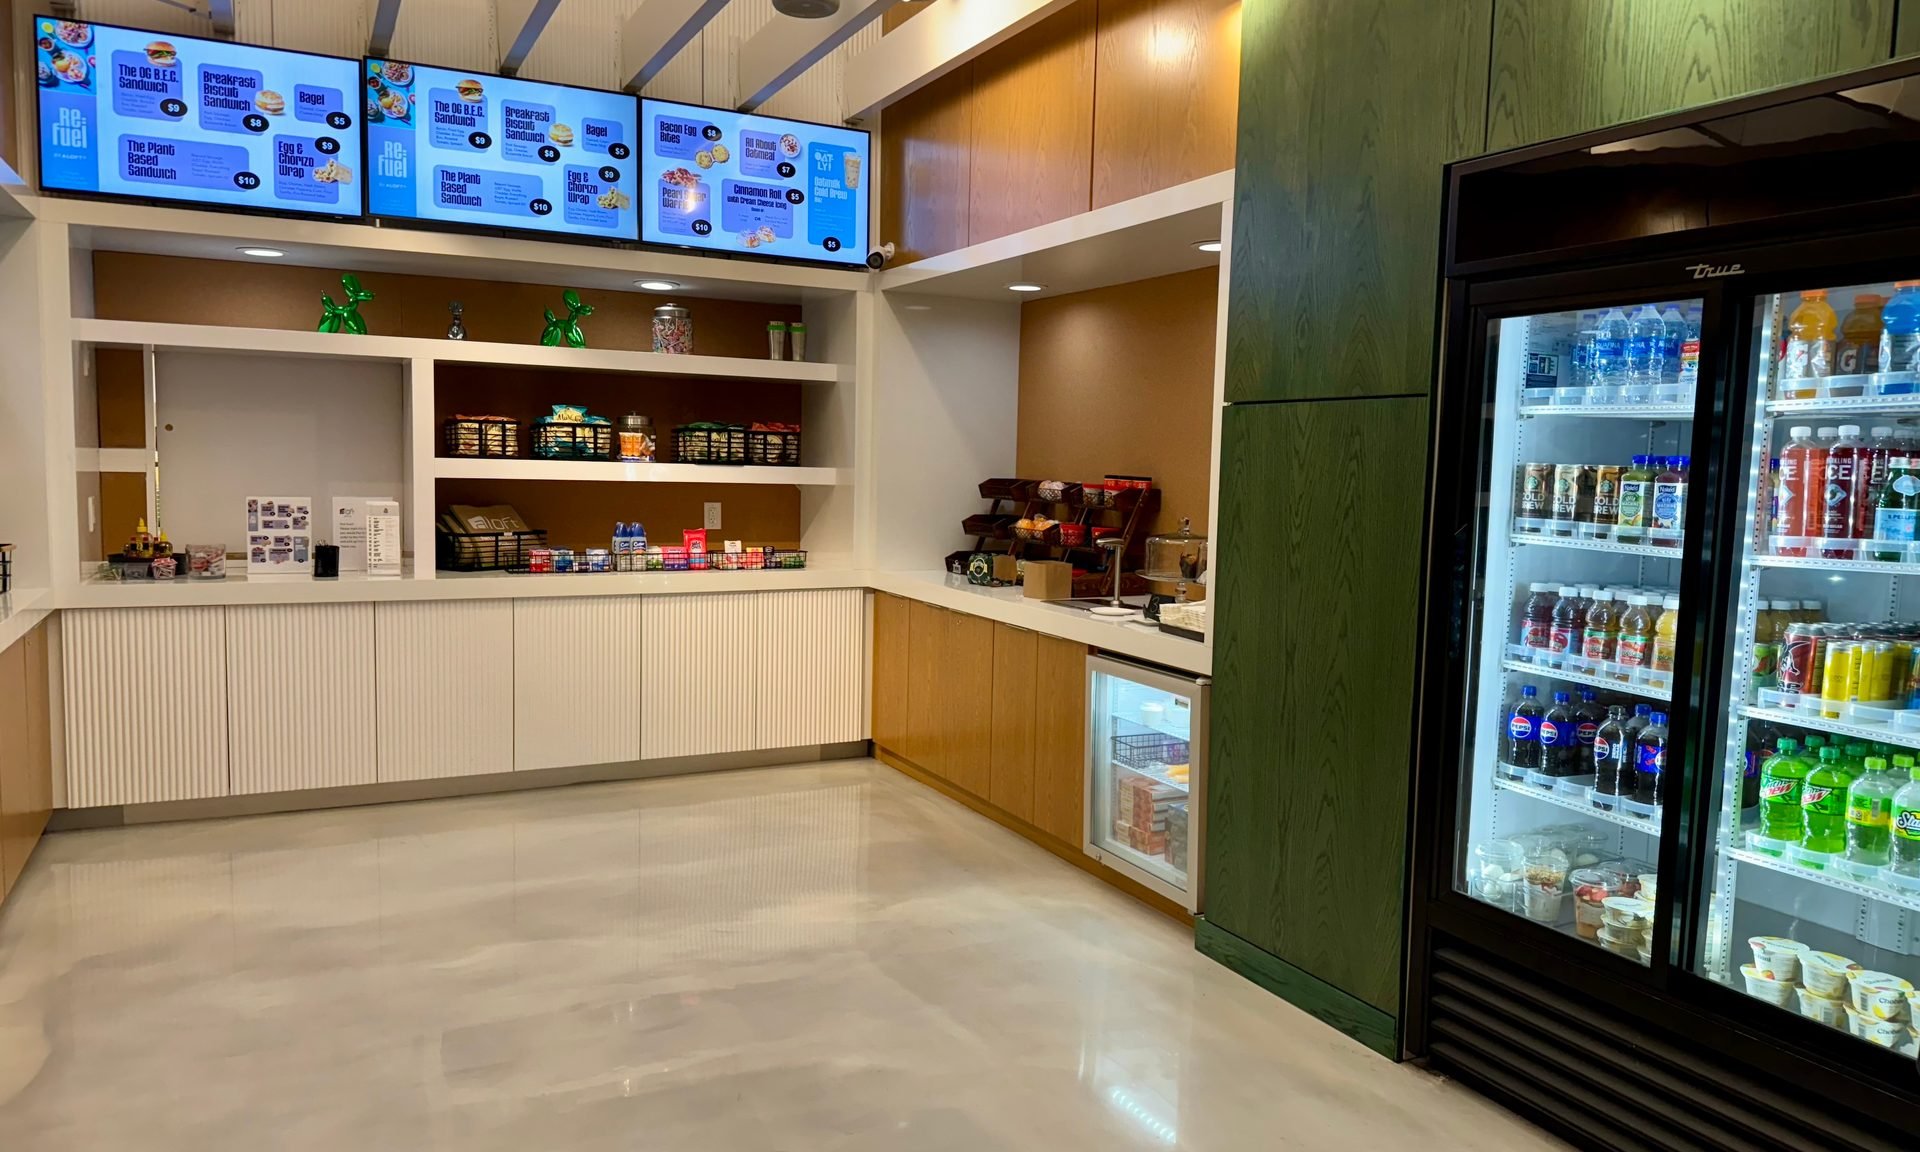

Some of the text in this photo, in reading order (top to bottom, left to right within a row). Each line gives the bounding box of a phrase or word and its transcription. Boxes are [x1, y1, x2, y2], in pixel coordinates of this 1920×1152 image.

[118, 64, 136, 77] The
[139, 66, 151, 78] OG
[119, 77, 168, 93] Sandwich
[203, 71, 256, 88] Breakfast
[204, 84, 238, 98] Biscuit
[204, 96, 250, 111] Sandwich
[299, 92, 325, 106] Bagel
[168, 103, 180, 112] $9
[434, 100, 450, 113] The
[452, 102, 462, 114] OG
[506, 106, 550, 122] Breakfast
[250, 118, 262, 127] $8
[334, 116, 346, 125] $5
[434, 112, 476, 127] Sandwich
[506, 118, 535, 131] Biscuit
[52, 122, 88, 149] fuel
[586, 124, 608, 137] Bagel
[660, 120, 697, 137] Bacon Egg
[506, 129, 545, 143] Sandwich
[660, 132, 680, 144] Bites
[127, 140, 175, 156] The Plant
[278, 141, 303, 155] Egg &
[322, 142, 333, 150] $9
[756, 139, 776, 151] About
[128, 152, 158, 166] Based
[278, 152, 314, 168] Chorizo
[746, 148, 775, 160] Oatmeal
[128, 164, 176, 180] Sandwich
[279, 164, 304, 178] Wrap
[440, 170, 481, 184] The Plant
[568, 170, 588, 183] Egg &
[782, 166, 790, 174] $7
[238, 176, 256, 185] $10
[441, 182, 466, 194] Based
[568, 182, 598, 195] Chorizo
[662, 187, 706, 202] Pearl Sar
[734, 184, 782, 200] Cinnamon Roll
[830, 190, 848, 200] Brew
[441, 193, 482, 207] Sandwich
[568, 192, 590, 205] Wrap
[534, 202, 548, 211] $10
[696, 223, 708, 231] $10
[1685, 264, 1745, 279] true
